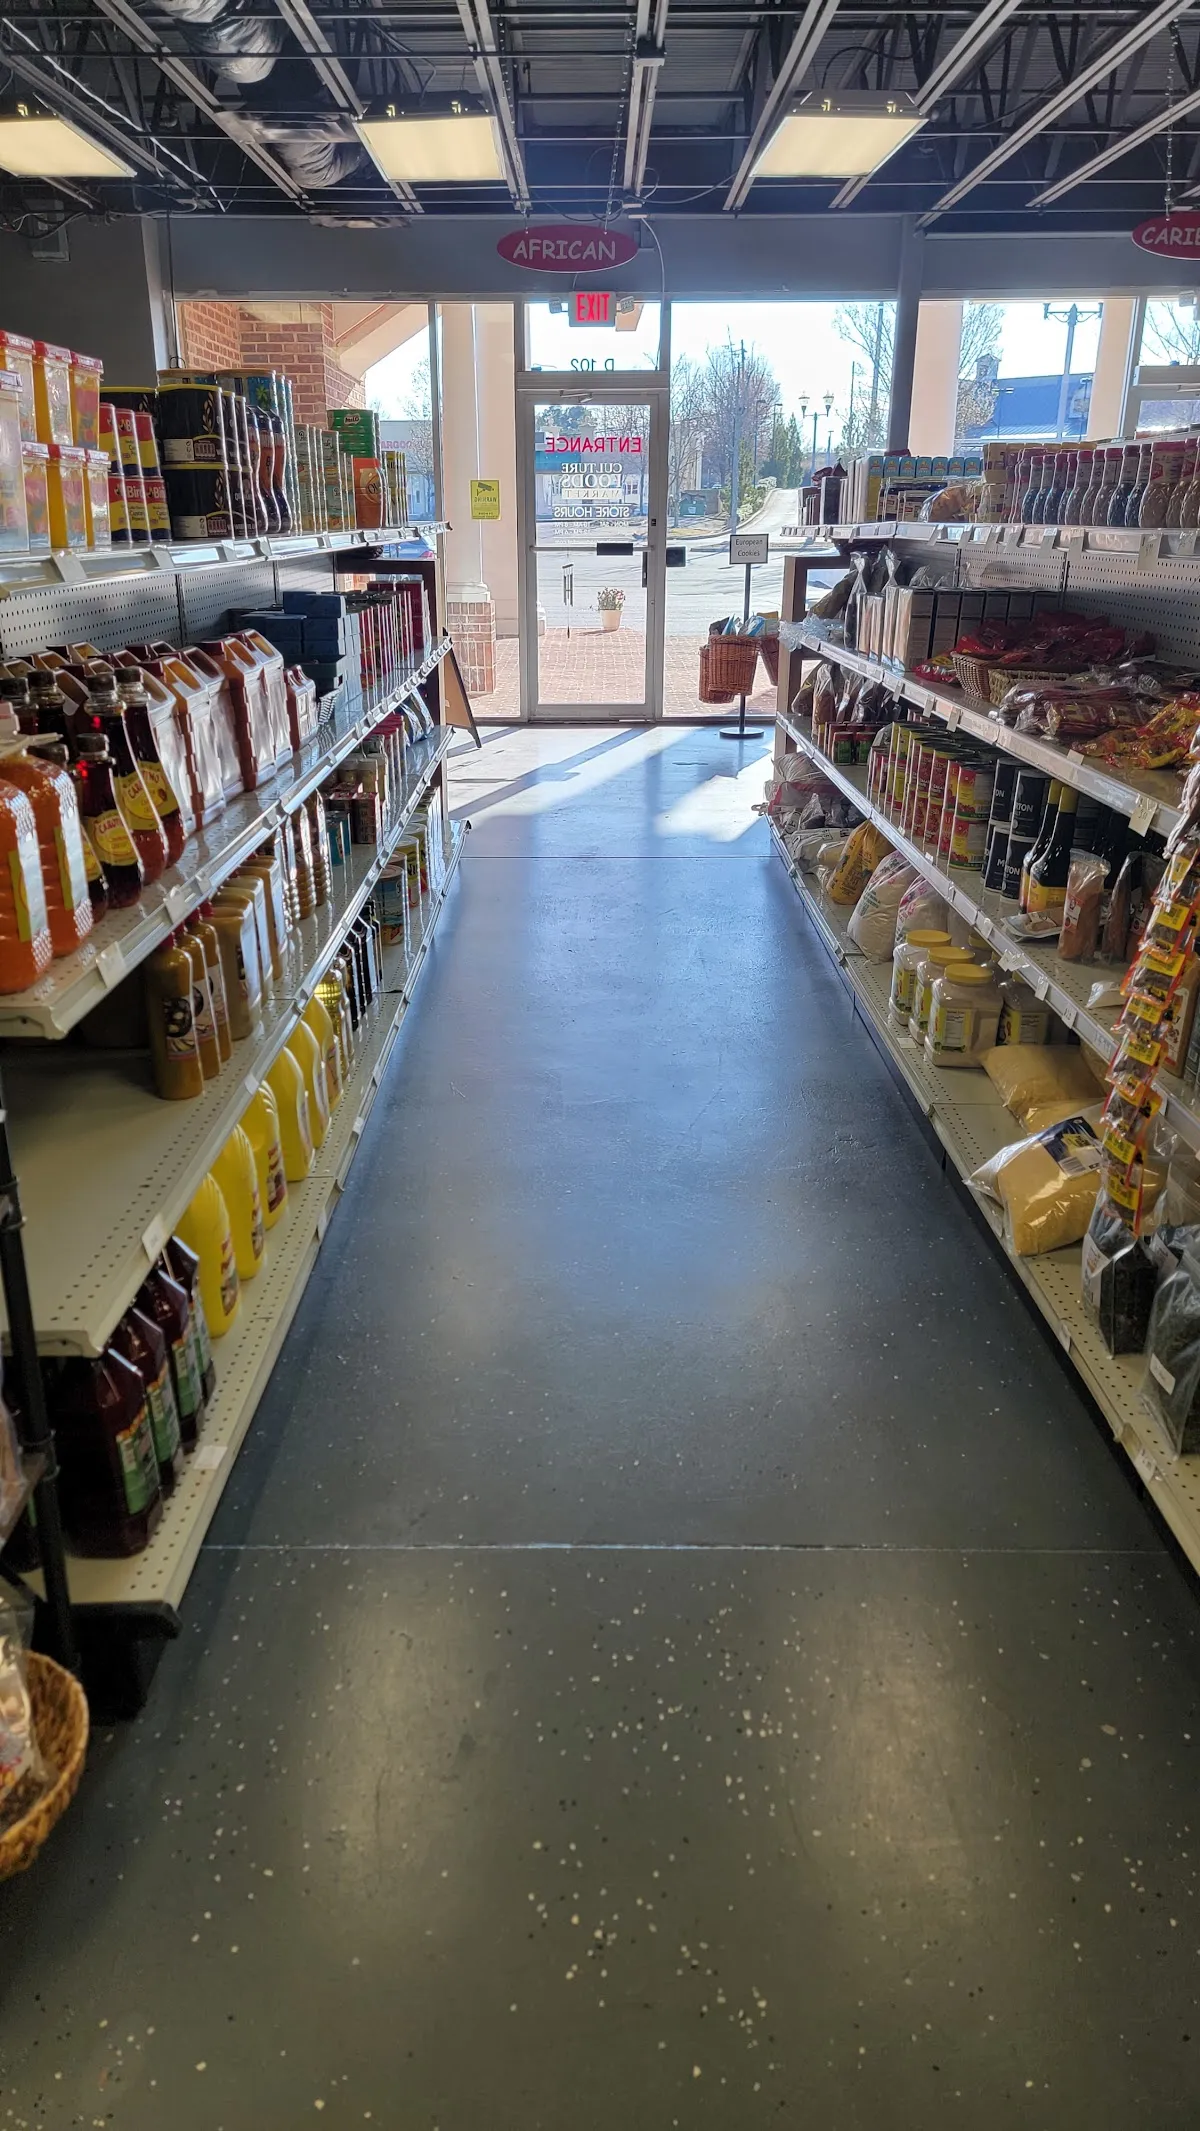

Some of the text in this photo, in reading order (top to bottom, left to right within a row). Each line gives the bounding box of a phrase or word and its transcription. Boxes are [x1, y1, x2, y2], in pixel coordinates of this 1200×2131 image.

[513, 239, 616, 260] AFRICAN
[576, 293, 610, 322] EXIT
[735, 538, 762, 546] European
